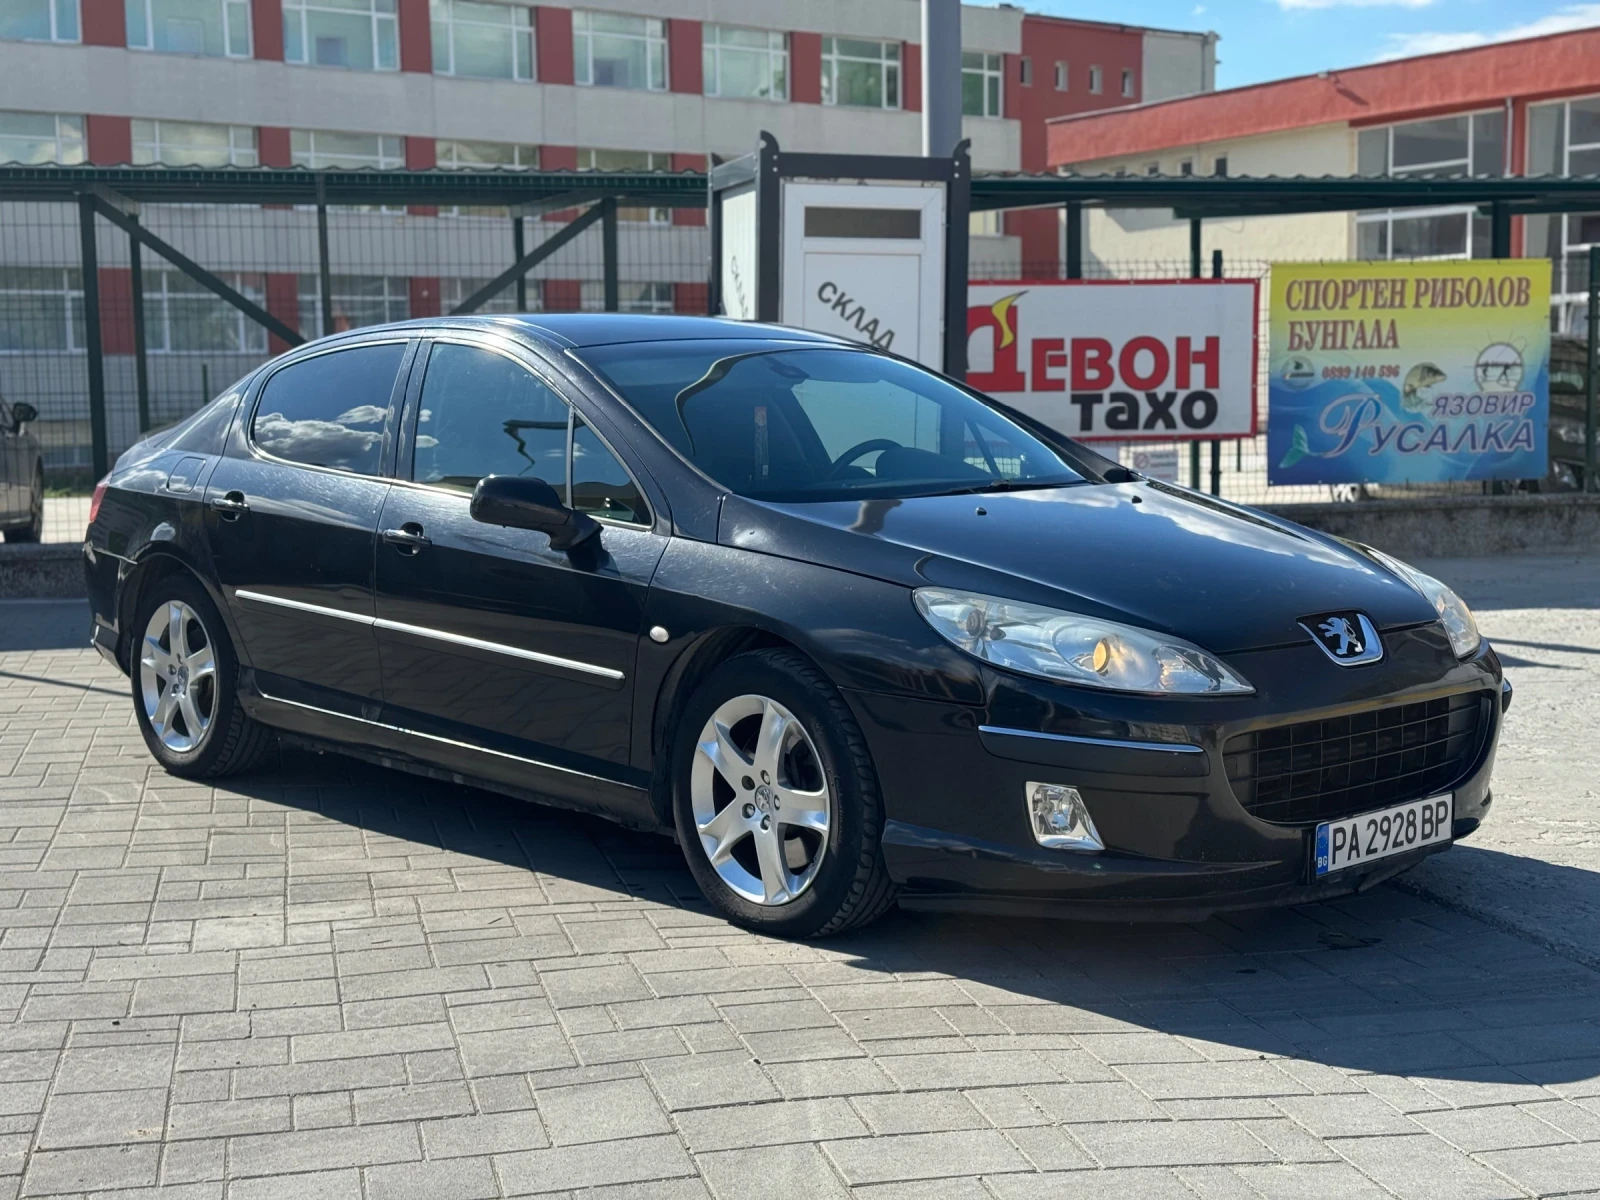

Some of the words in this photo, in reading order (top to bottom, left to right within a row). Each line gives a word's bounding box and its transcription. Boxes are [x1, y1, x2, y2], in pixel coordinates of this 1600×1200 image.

[818, 281, 895, 351] СКЛАД
[1286, 278, 1408, 311] СПОРТЕН
[1412, 276, 1531, 309] РИБОЛОВ
[967, 304, 1219, 391] ДЕВОН
[1287, 319, 1400, 351] БУНГАЛА
[1319, 392, 1535, 458] РУСАЛКА
[1432, 392, 1535, 418] ЯЗОВИР
[1332, 823, 1360, 865] PA
[1366, 809, 1417, 856] 2928
[1421, 801, 1448, 840] BP
[1318, 856, 1328, 867] BG
